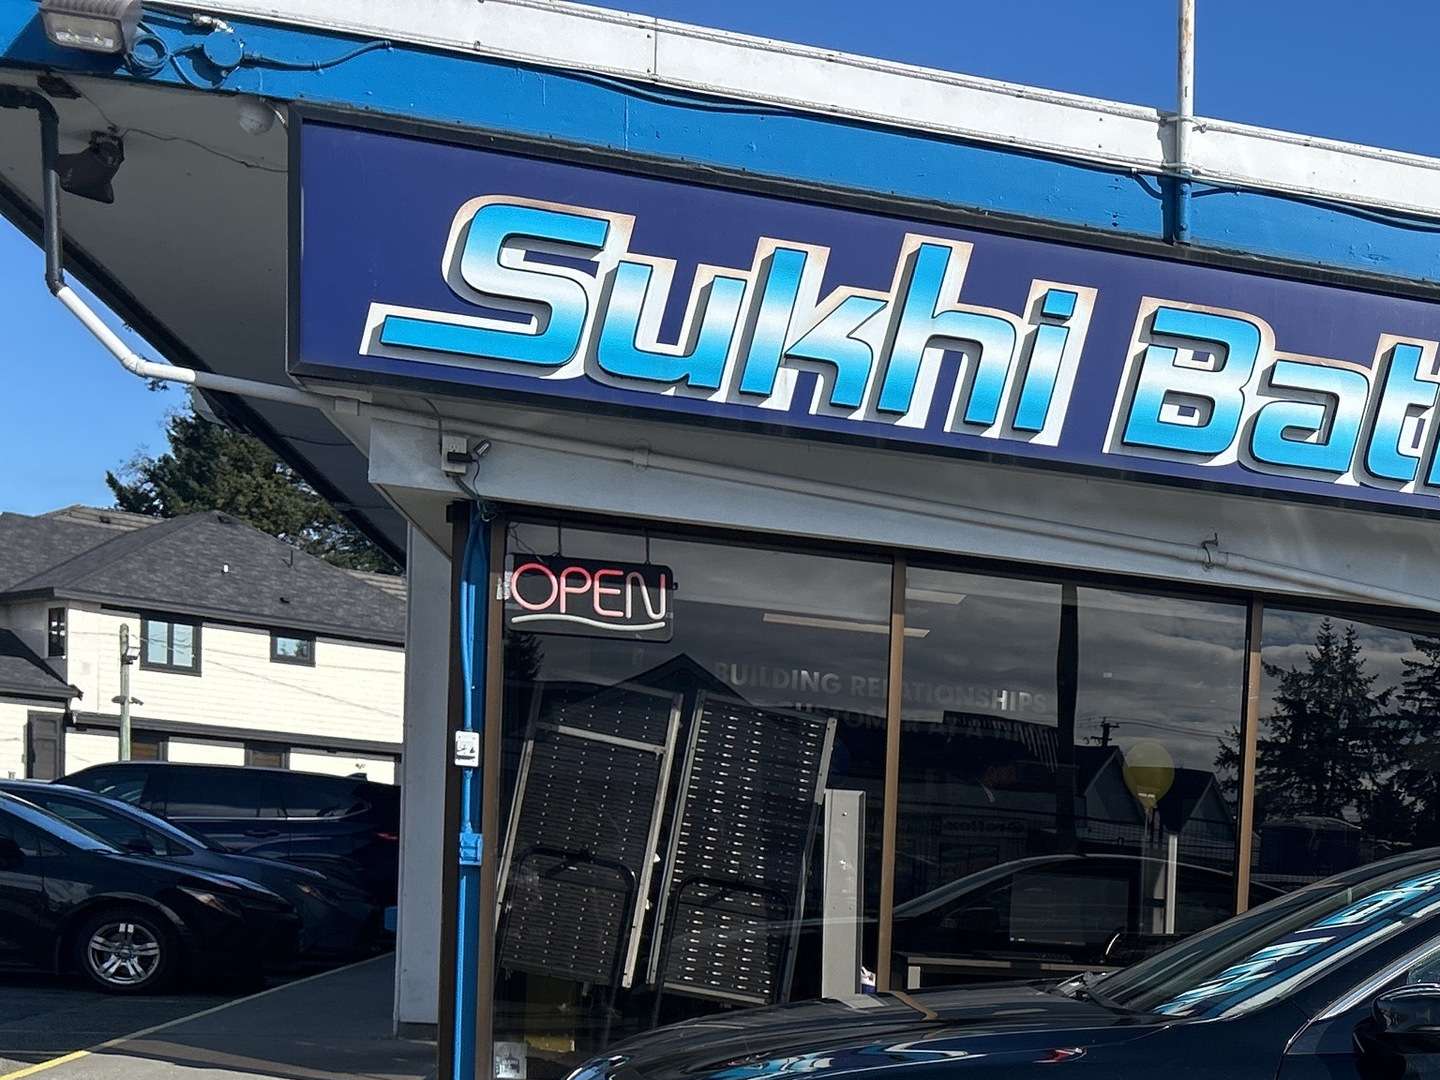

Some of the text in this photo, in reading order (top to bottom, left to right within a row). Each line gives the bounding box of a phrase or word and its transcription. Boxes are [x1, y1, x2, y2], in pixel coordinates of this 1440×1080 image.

[359, 194, 1098, 446] Sukhi
[511, 563, 666, 620] OPEN
[715, 662, 841, 693] BUILDING
